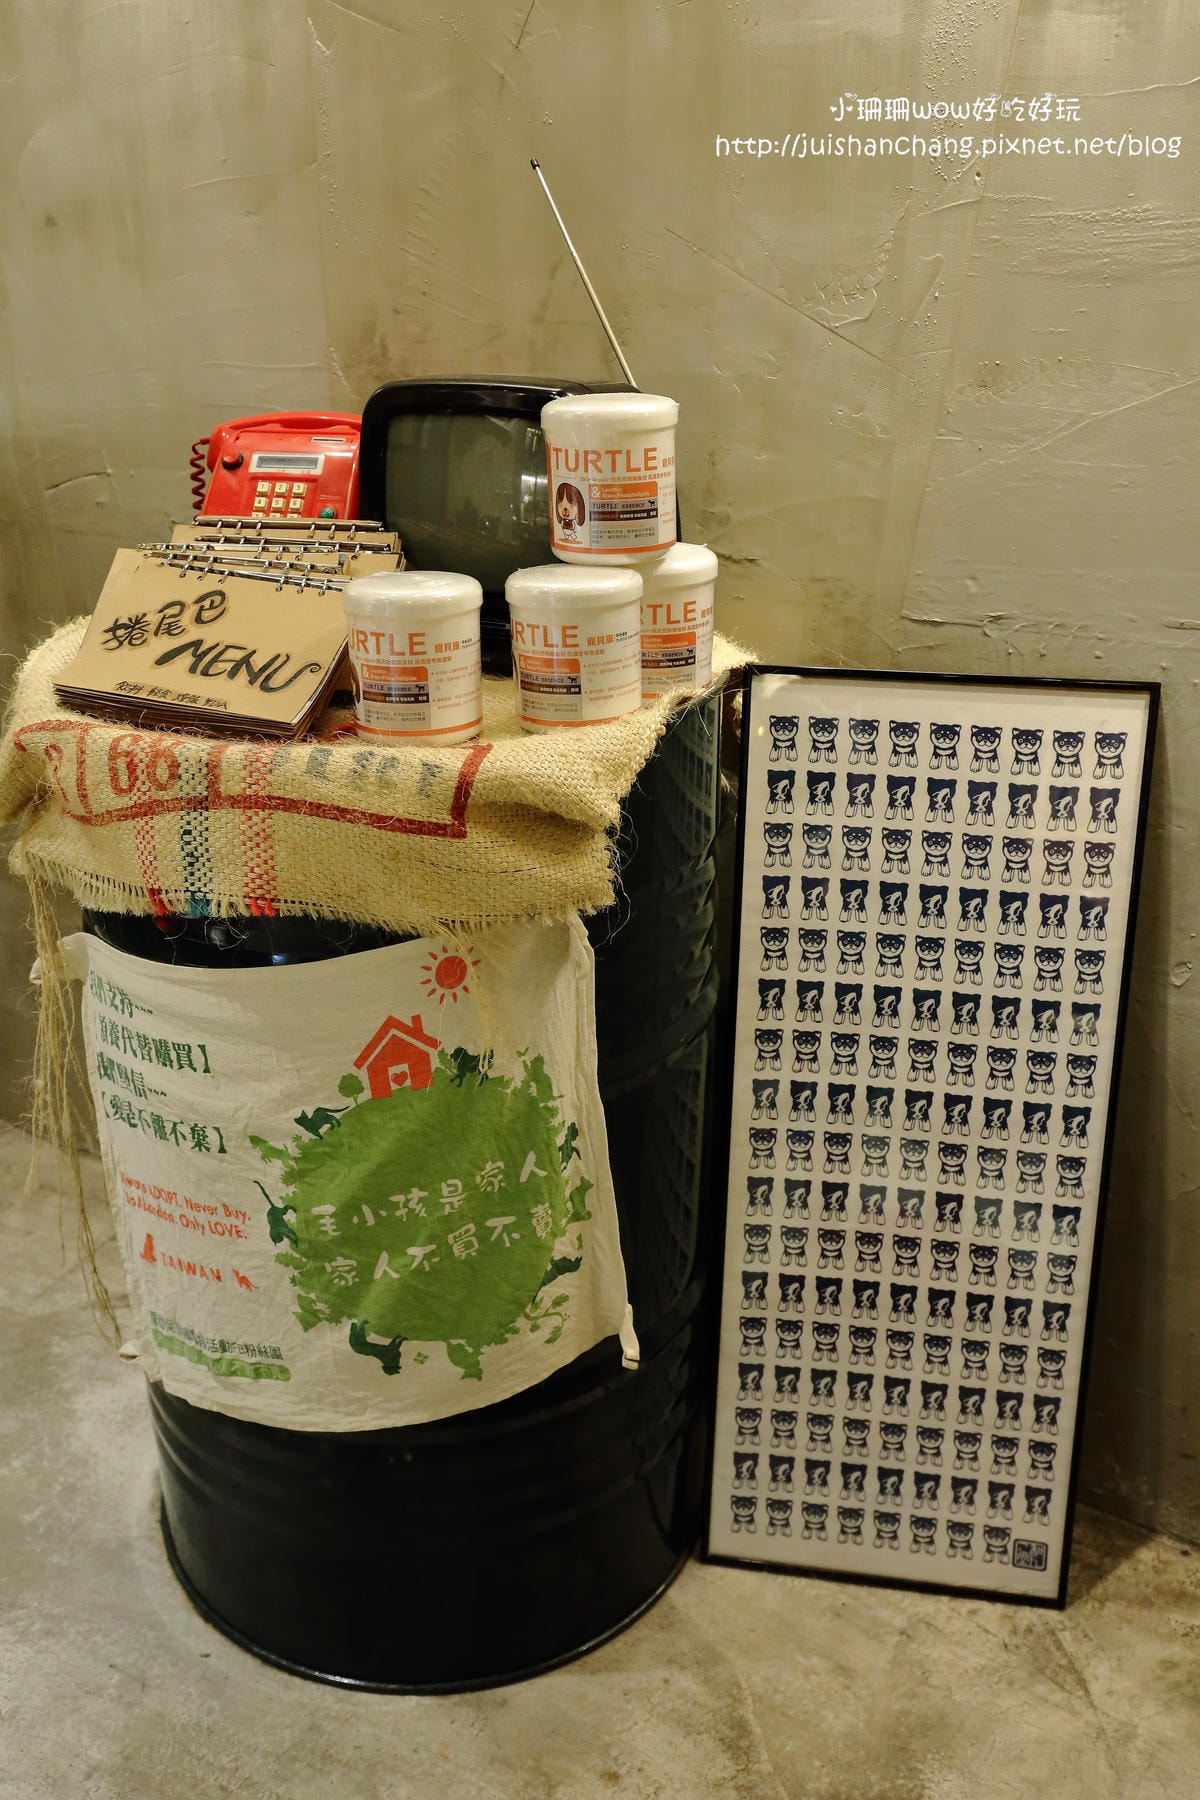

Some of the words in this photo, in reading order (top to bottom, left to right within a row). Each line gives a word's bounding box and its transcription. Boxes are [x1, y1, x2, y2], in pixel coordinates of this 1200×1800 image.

[552, 447, 658, 474] TURTLE
[154, 639, 322, 693] MENU
[310, 1150, 548, 1237] 毛小孩是家人
[183, 1195, 218, 1216] Never
[222, 1203, 251, 1225] Buy.
[178, 1213, 205, 1236] Only
[207, 1220, 247, 1240] LOVE.
[324, 1202, 553, 1287] 家人不買不賣
[160, 1252, 222, 1283] TAIWAN
